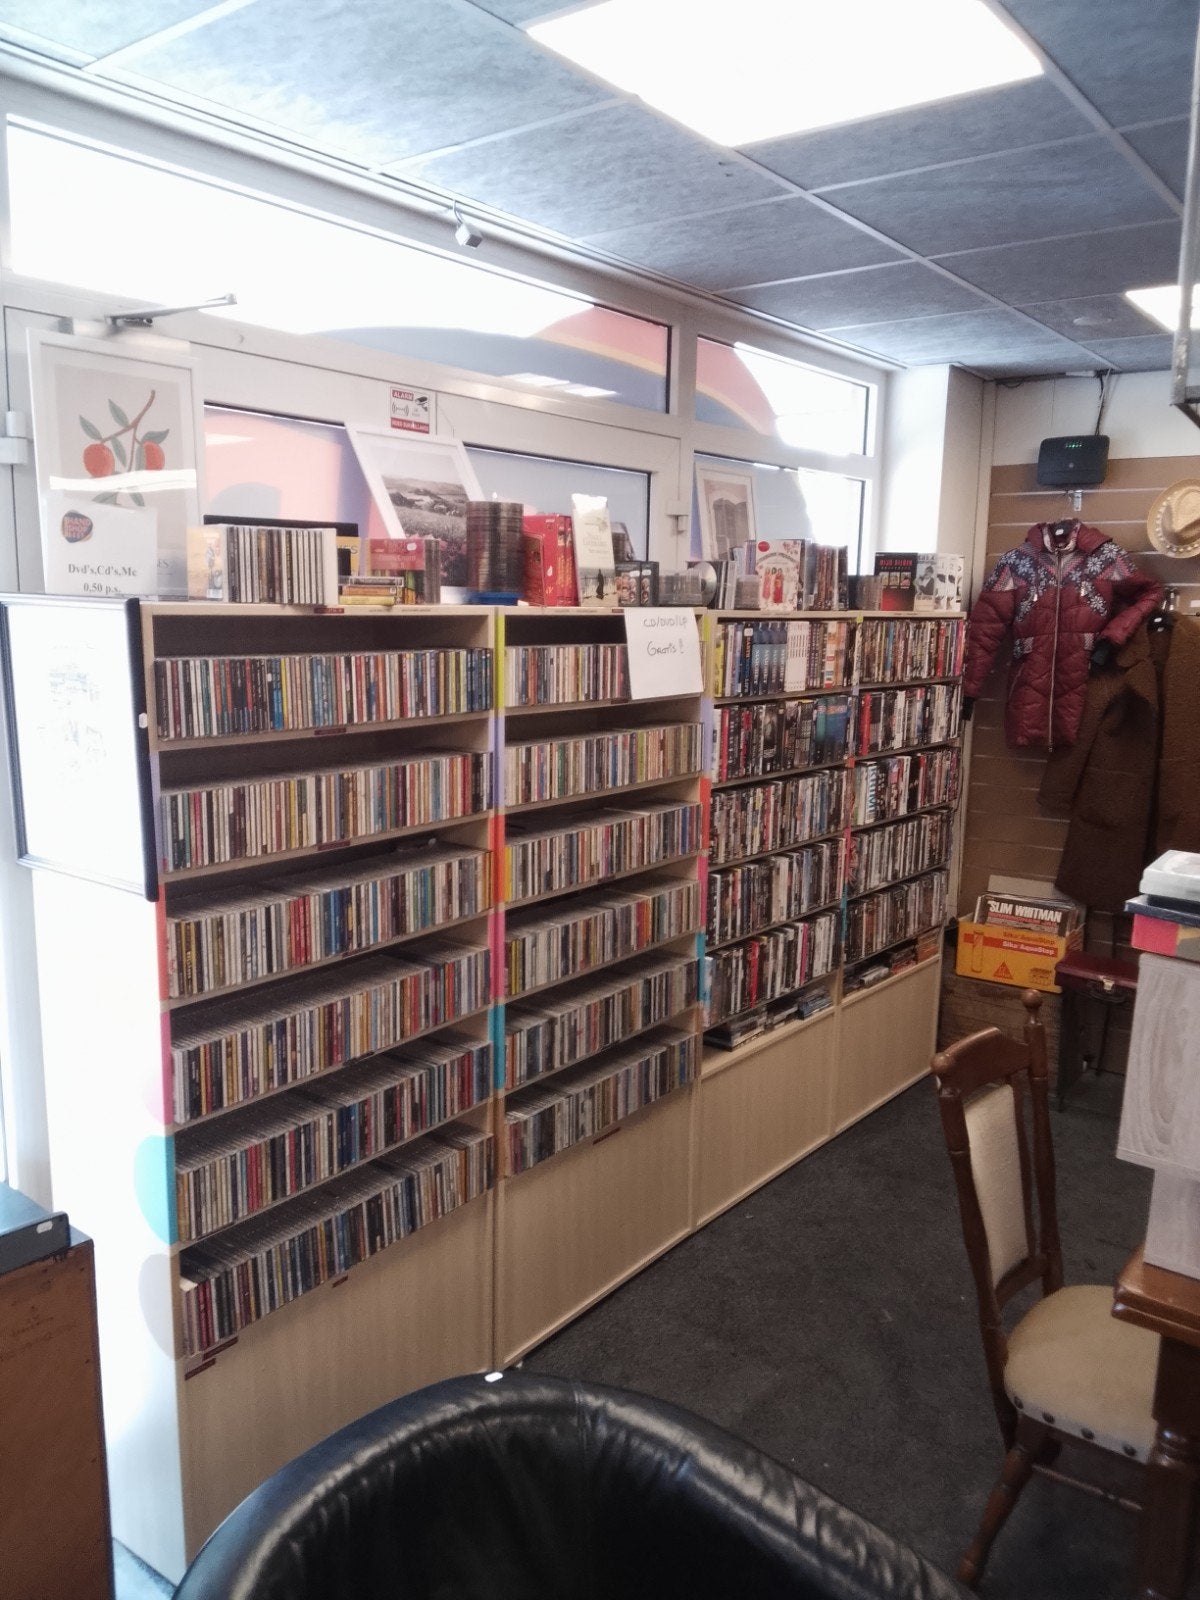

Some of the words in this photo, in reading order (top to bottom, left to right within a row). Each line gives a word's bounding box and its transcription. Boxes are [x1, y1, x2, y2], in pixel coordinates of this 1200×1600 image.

[393, 391, 413, 400] ALARM
[988, 901, 1014, 915] SLIM
[1015, 905, 1062, 923] WHITMAN
